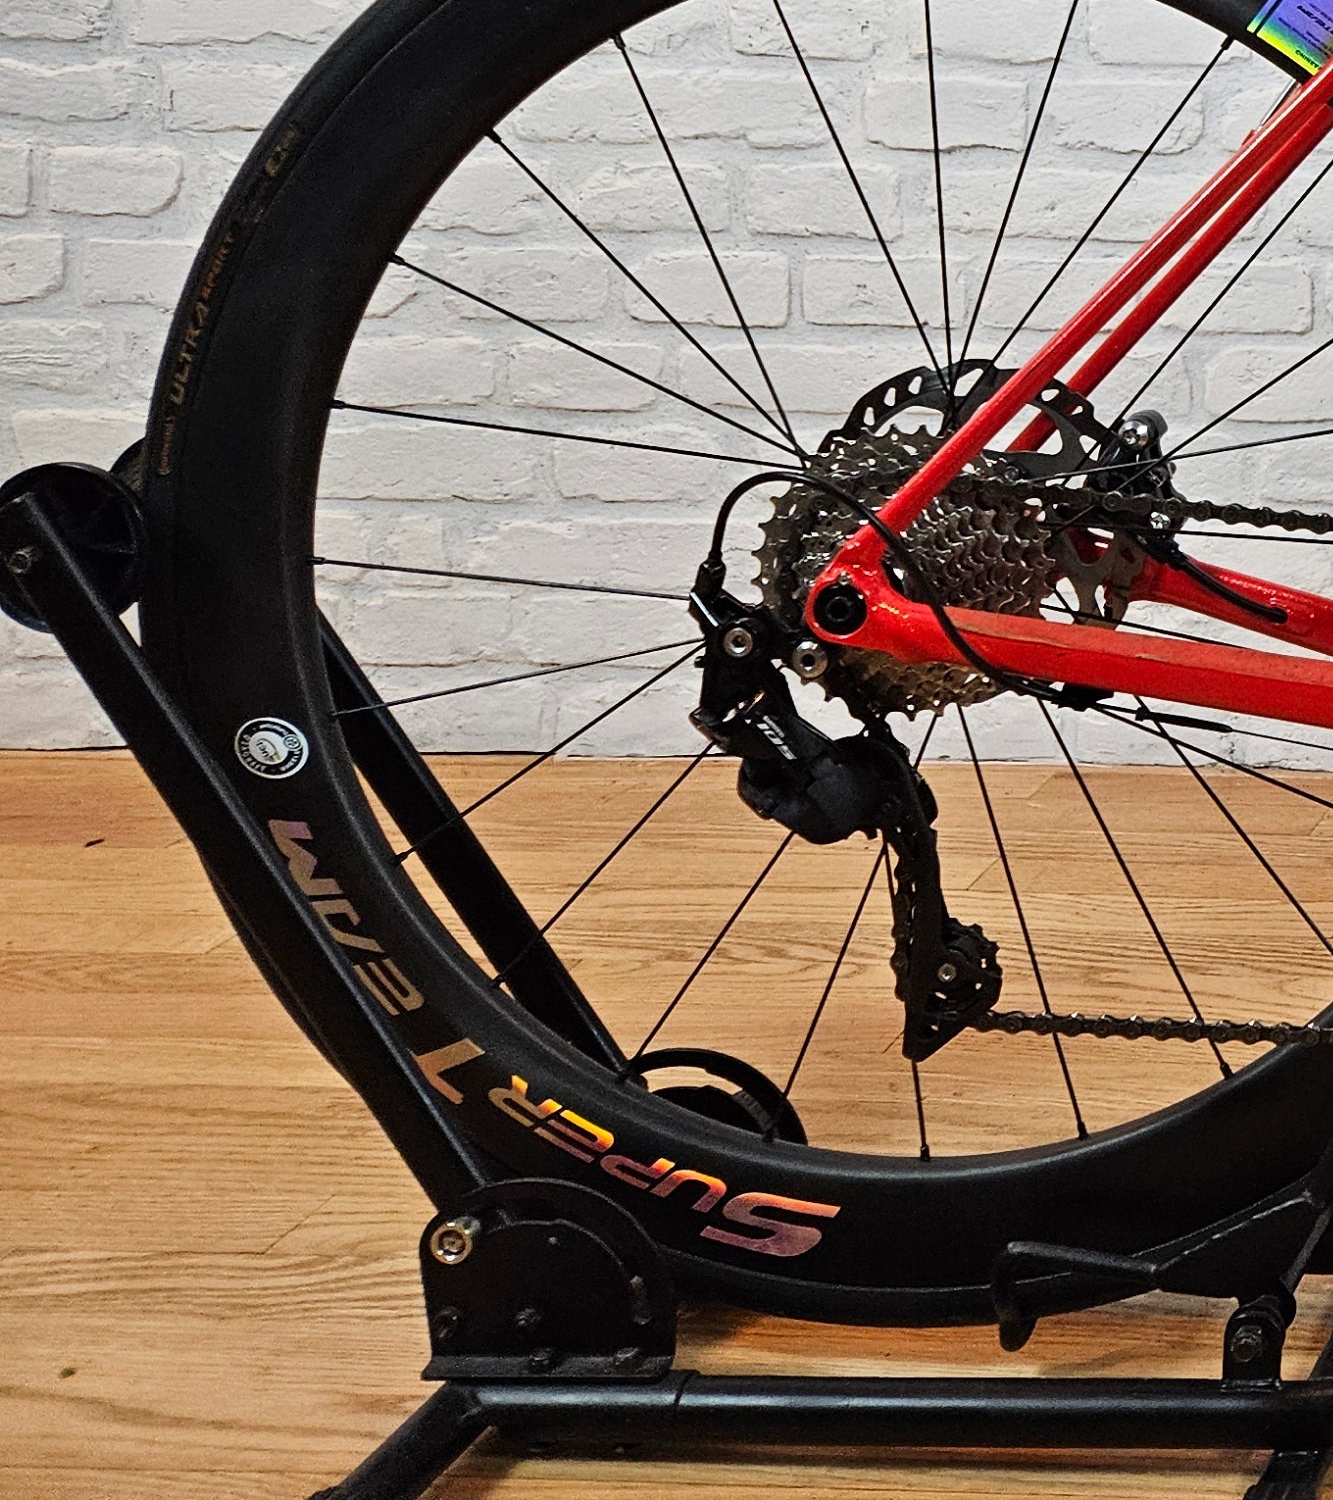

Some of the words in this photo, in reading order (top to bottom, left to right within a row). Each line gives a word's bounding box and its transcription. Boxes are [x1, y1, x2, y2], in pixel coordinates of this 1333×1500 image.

[757, 722, 797, 760] 105
[268, 818, 487, 1105] TEAM
[488, 1074, 841, 1257] SUPER
